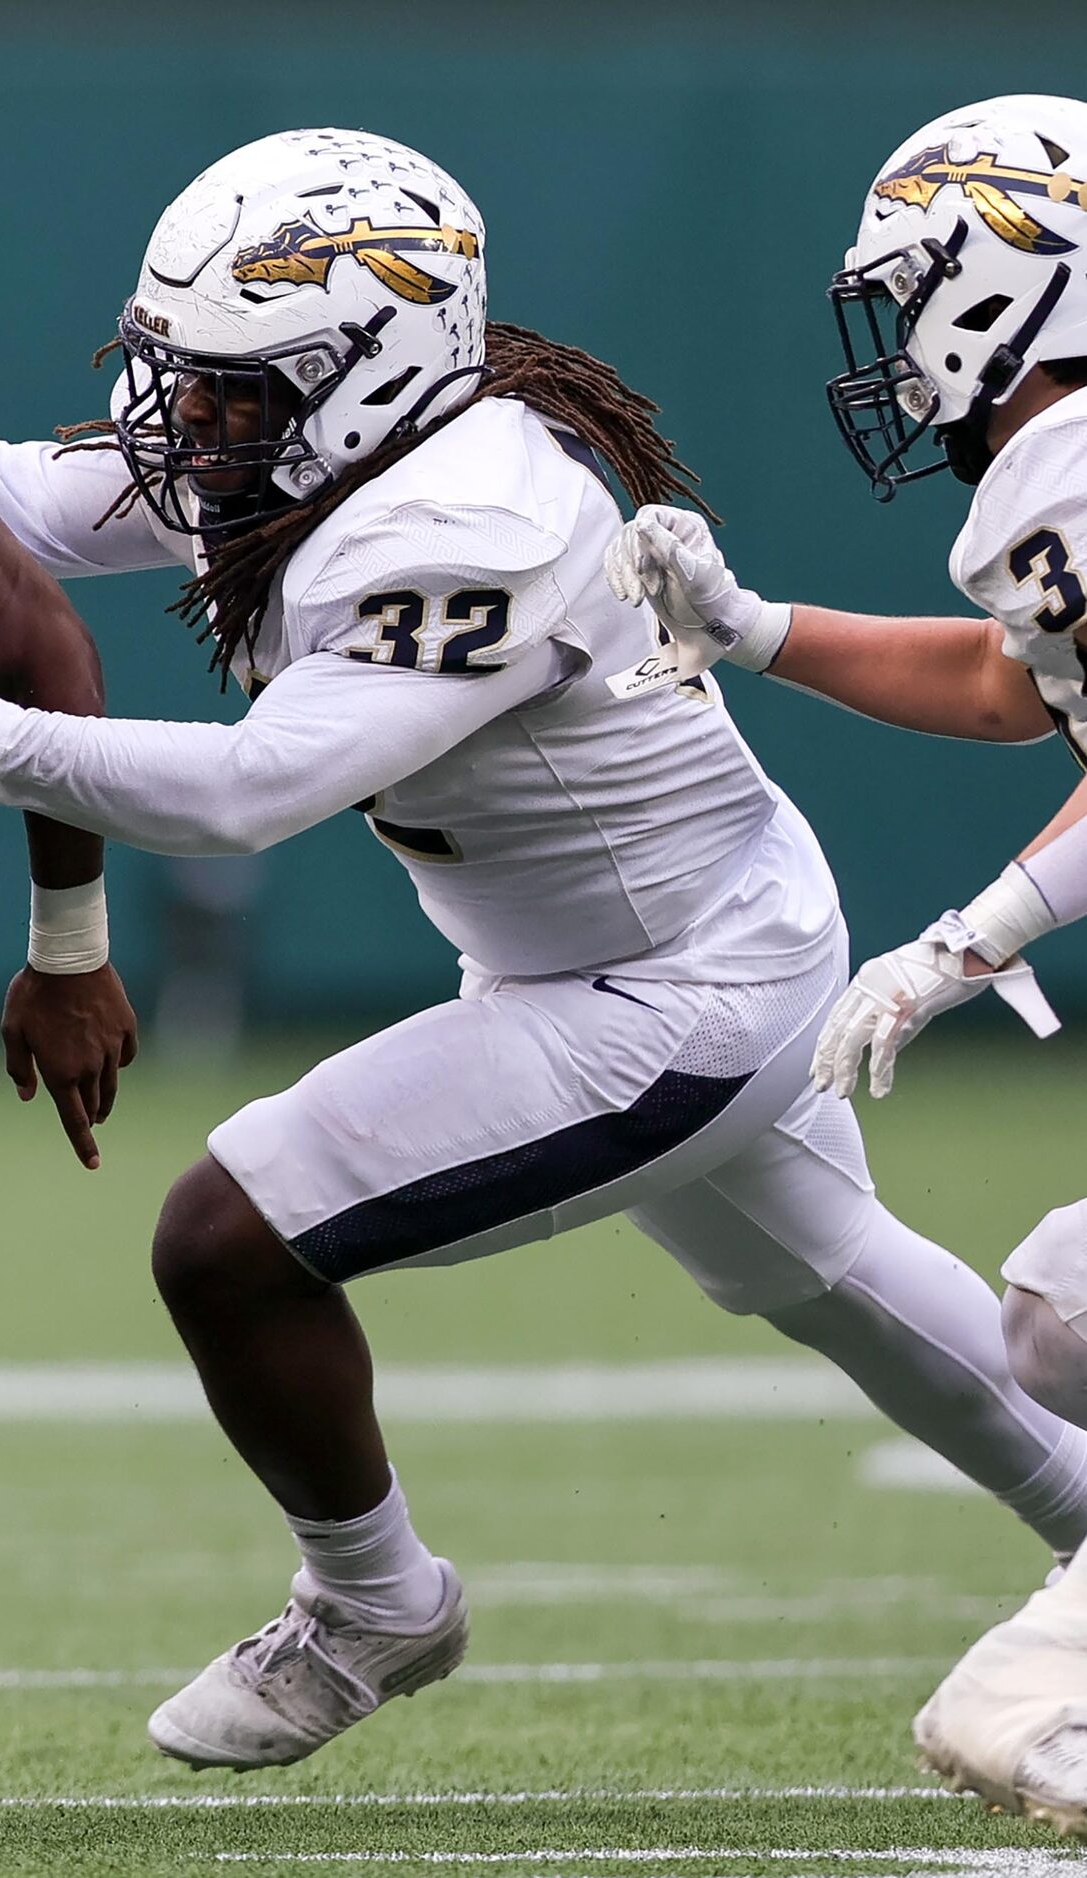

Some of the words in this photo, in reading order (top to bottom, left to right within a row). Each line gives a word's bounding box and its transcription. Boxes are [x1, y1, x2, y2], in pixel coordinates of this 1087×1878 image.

[1005, 524, 1087, 633] 3
[343, 584, 514, 674] 32
[625, 666, 679, 690] CUTTERS
